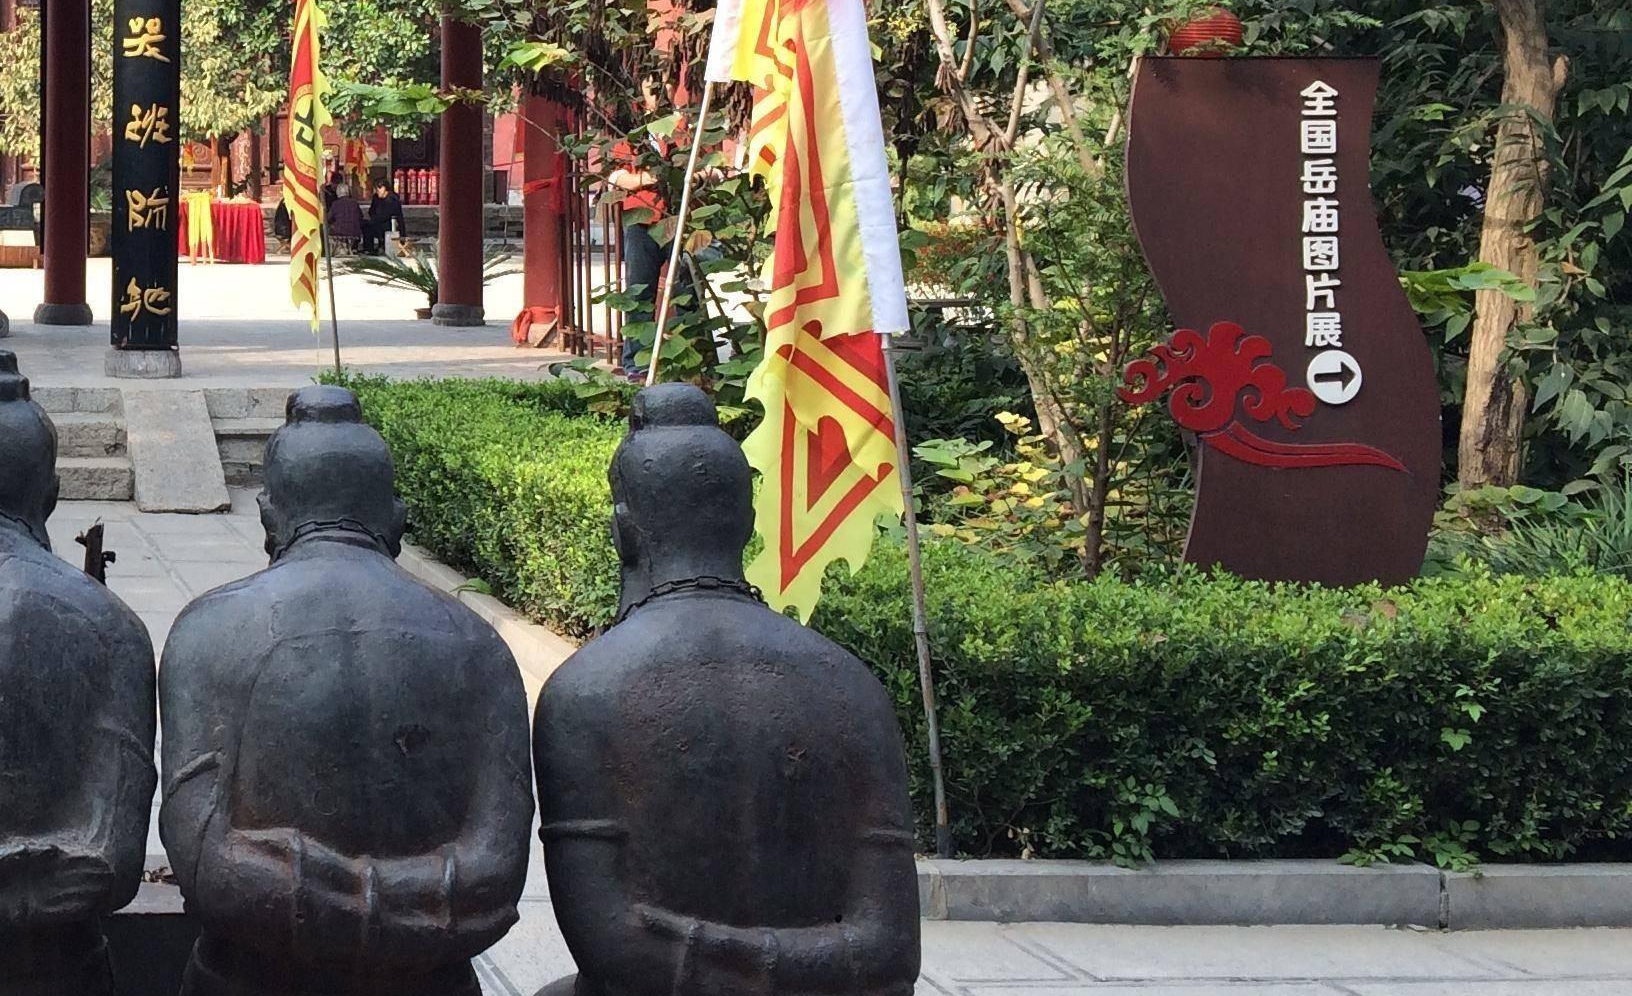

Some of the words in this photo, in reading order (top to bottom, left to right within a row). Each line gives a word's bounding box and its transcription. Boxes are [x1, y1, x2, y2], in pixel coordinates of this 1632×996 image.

[1300, 80, 1343, 348] 全国岳庙图片展
